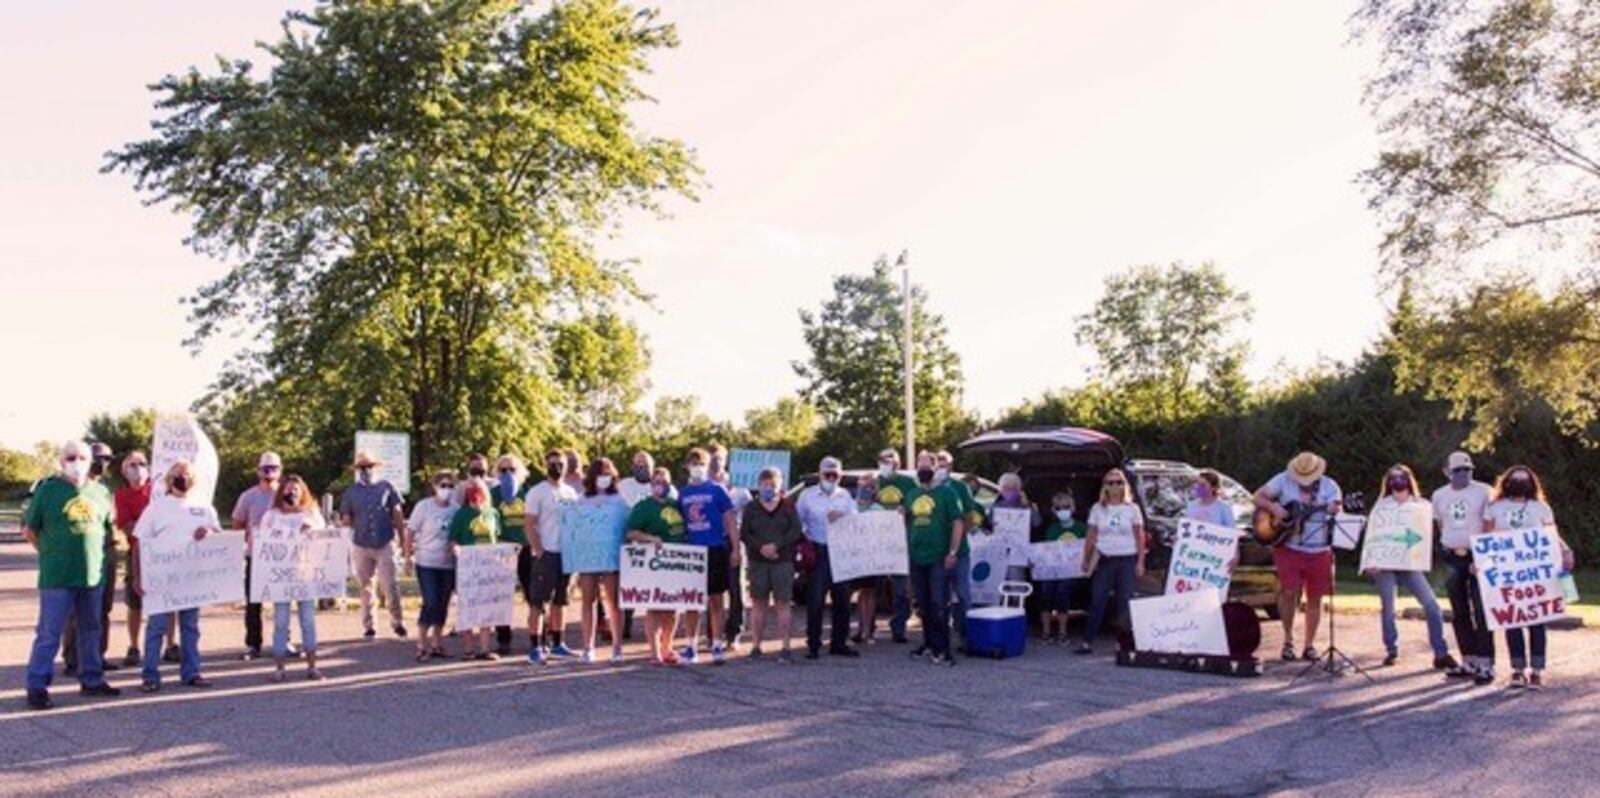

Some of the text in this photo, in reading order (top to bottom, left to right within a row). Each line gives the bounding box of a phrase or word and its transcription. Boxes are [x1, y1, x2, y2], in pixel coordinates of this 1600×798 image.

[1182, 522, 1191, 538] I
[260, 543, 288, 561] AND
[1485, 564, 1553, 587] FIGHT
[1500, 584, 1546, 603] FOOD
[1490, 597, 1564, 625] WASTE
